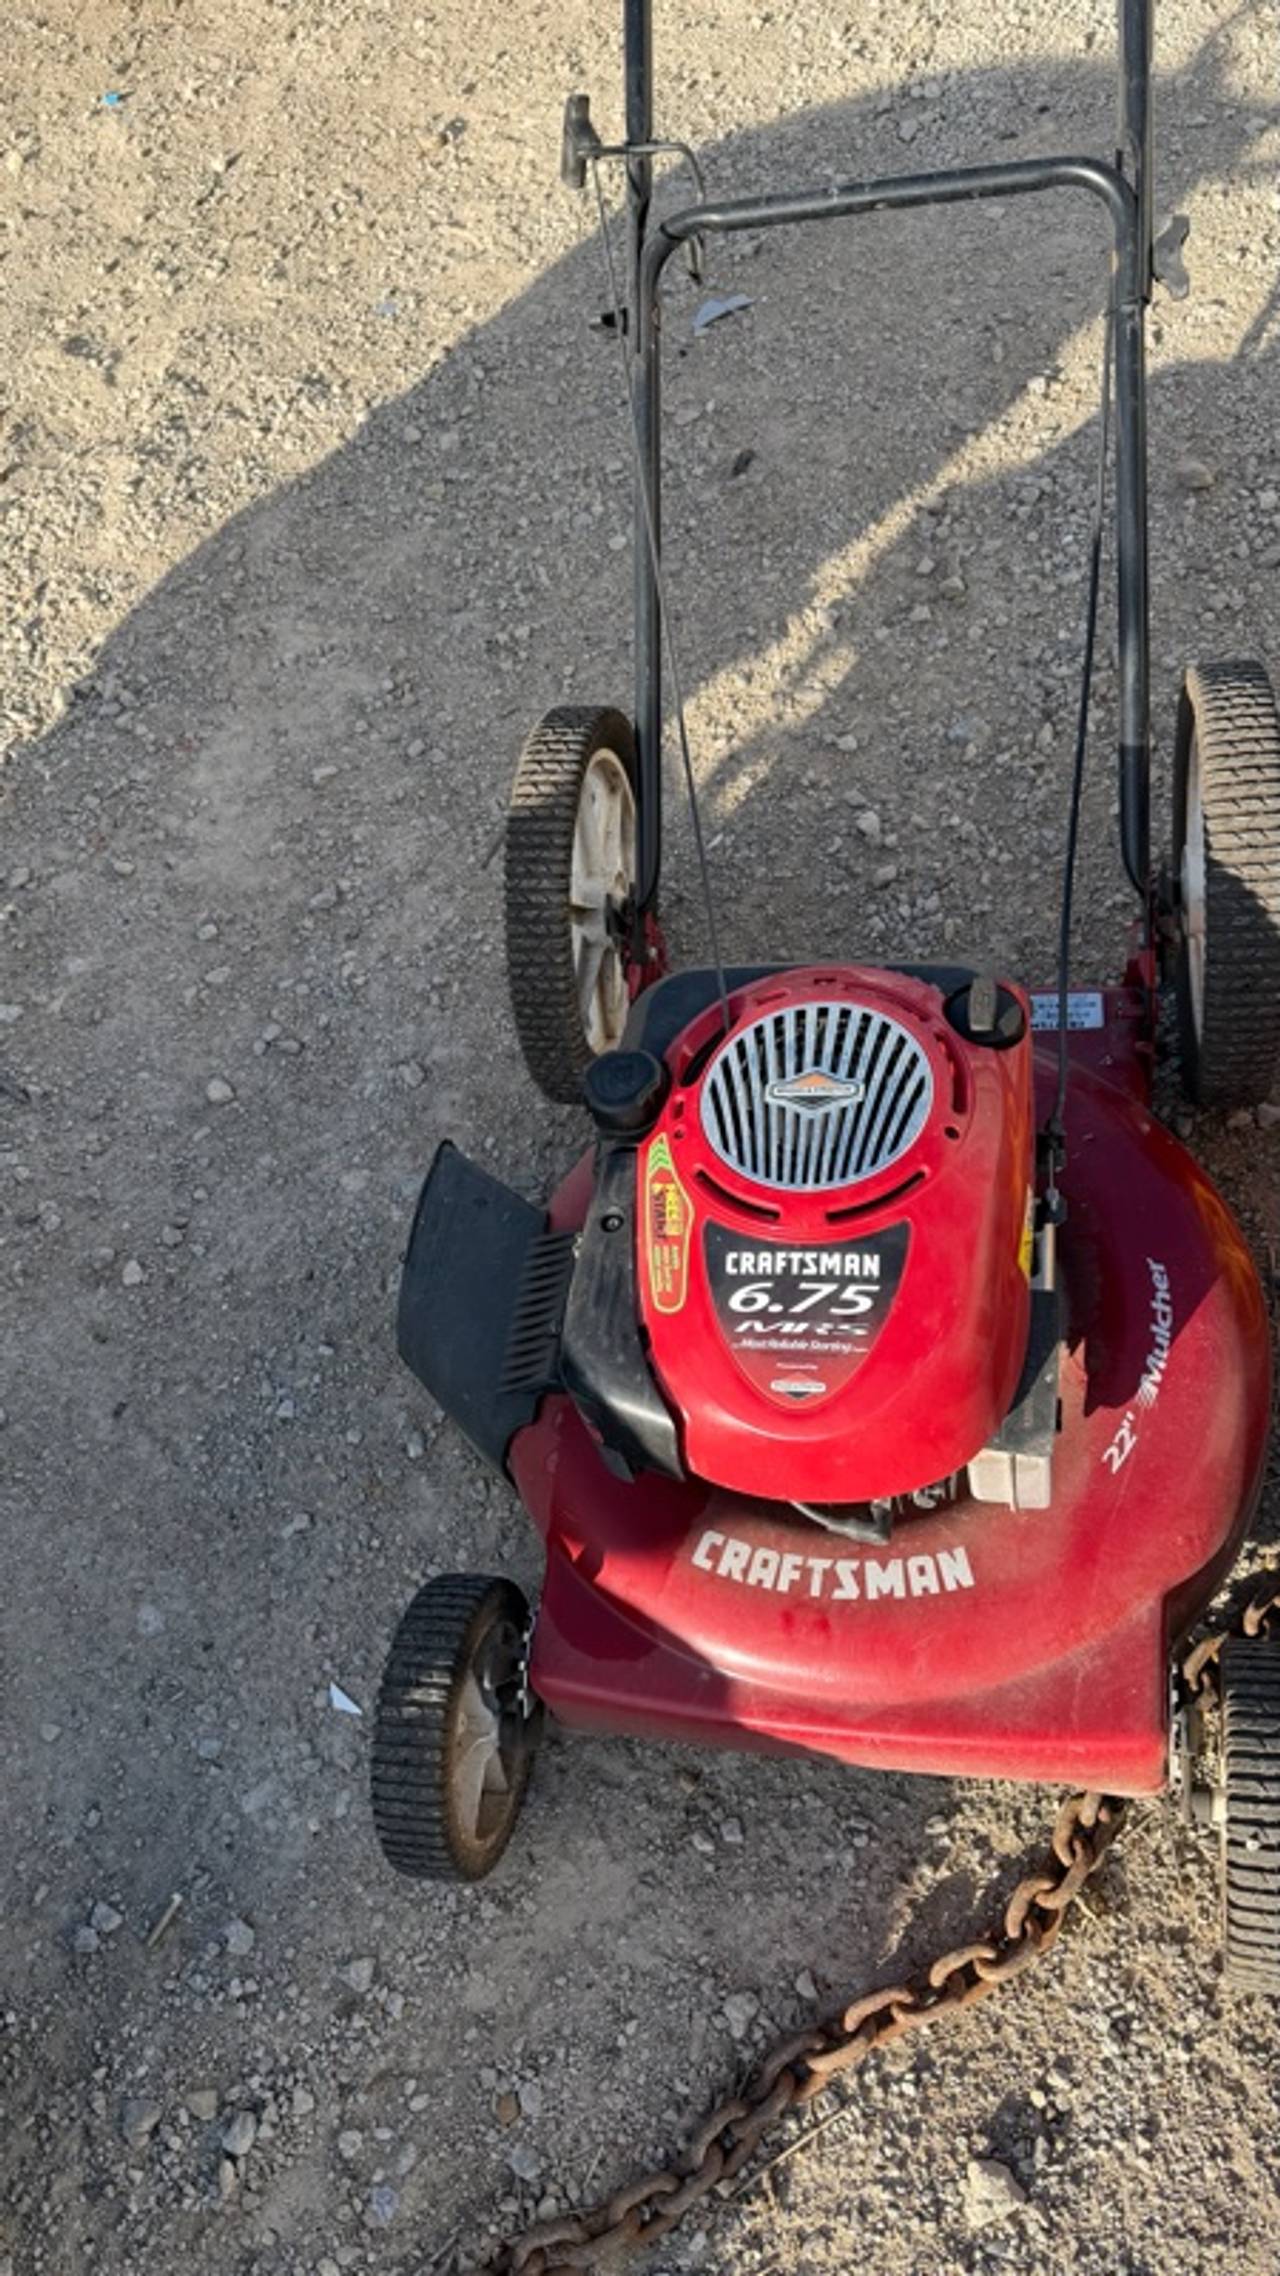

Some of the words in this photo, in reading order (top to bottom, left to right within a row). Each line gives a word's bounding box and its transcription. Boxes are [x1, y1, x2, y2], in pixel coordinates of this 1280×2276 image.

[725, 1251, 881, 1277] CRAFTSMAN
[728, 1282, 881, 1316] 6.75
[1138, 1257, 1173, 1404] Mulcher
[691, 1529, 976, 1601] CRAFTSMAN
